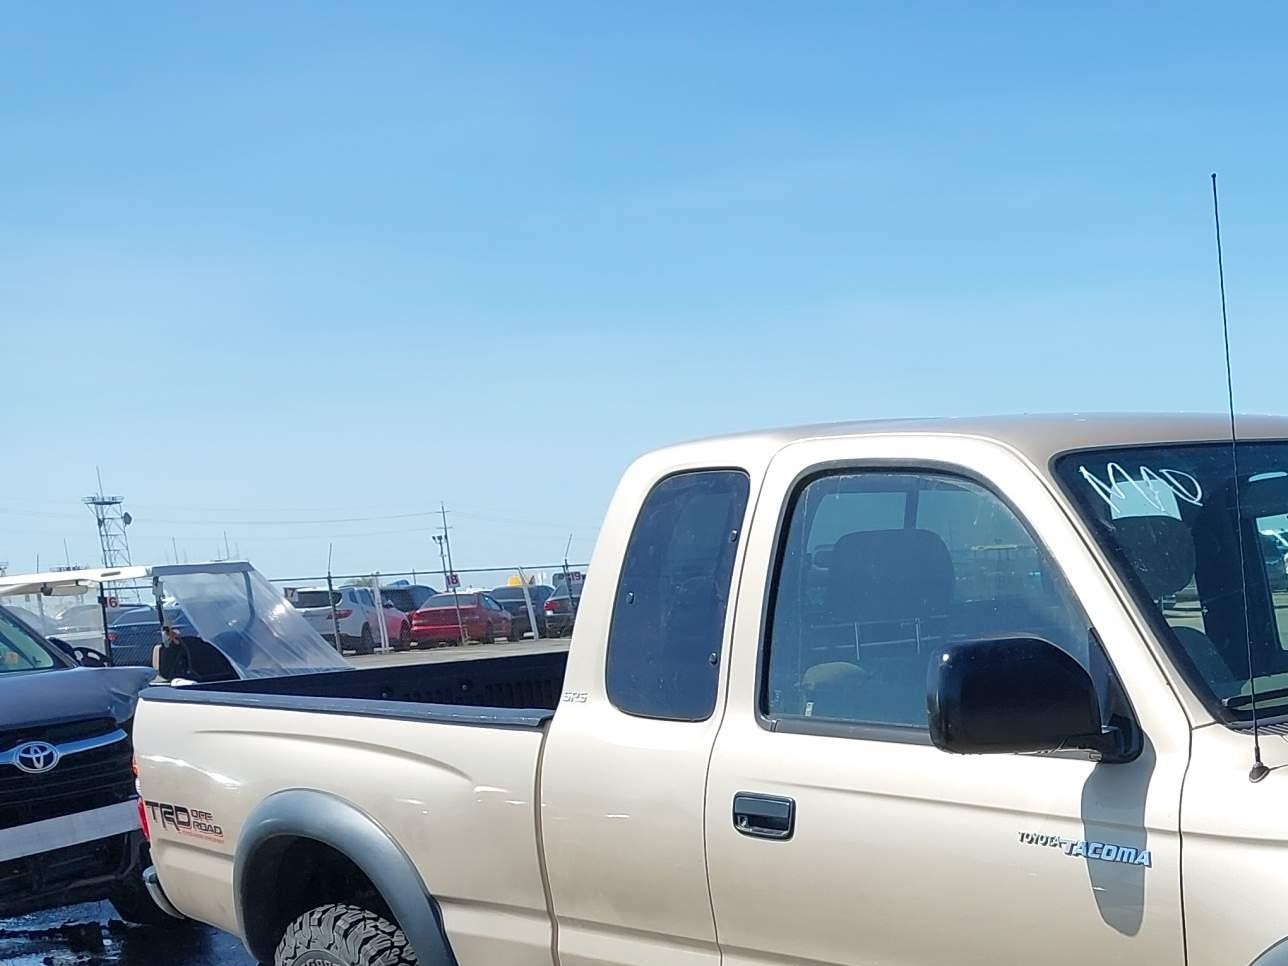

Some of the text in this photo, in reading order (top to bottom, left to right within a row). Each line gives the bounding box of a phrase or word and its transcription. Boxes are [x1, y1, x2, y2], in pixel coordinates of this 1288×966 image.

[145, 800, 191, 832] TRD
[191, 809, 214, 821] OFF
[193, 821, 224, 836] ROAD
[1018, 831, 1153, 869] TOYOTA TACOMA
